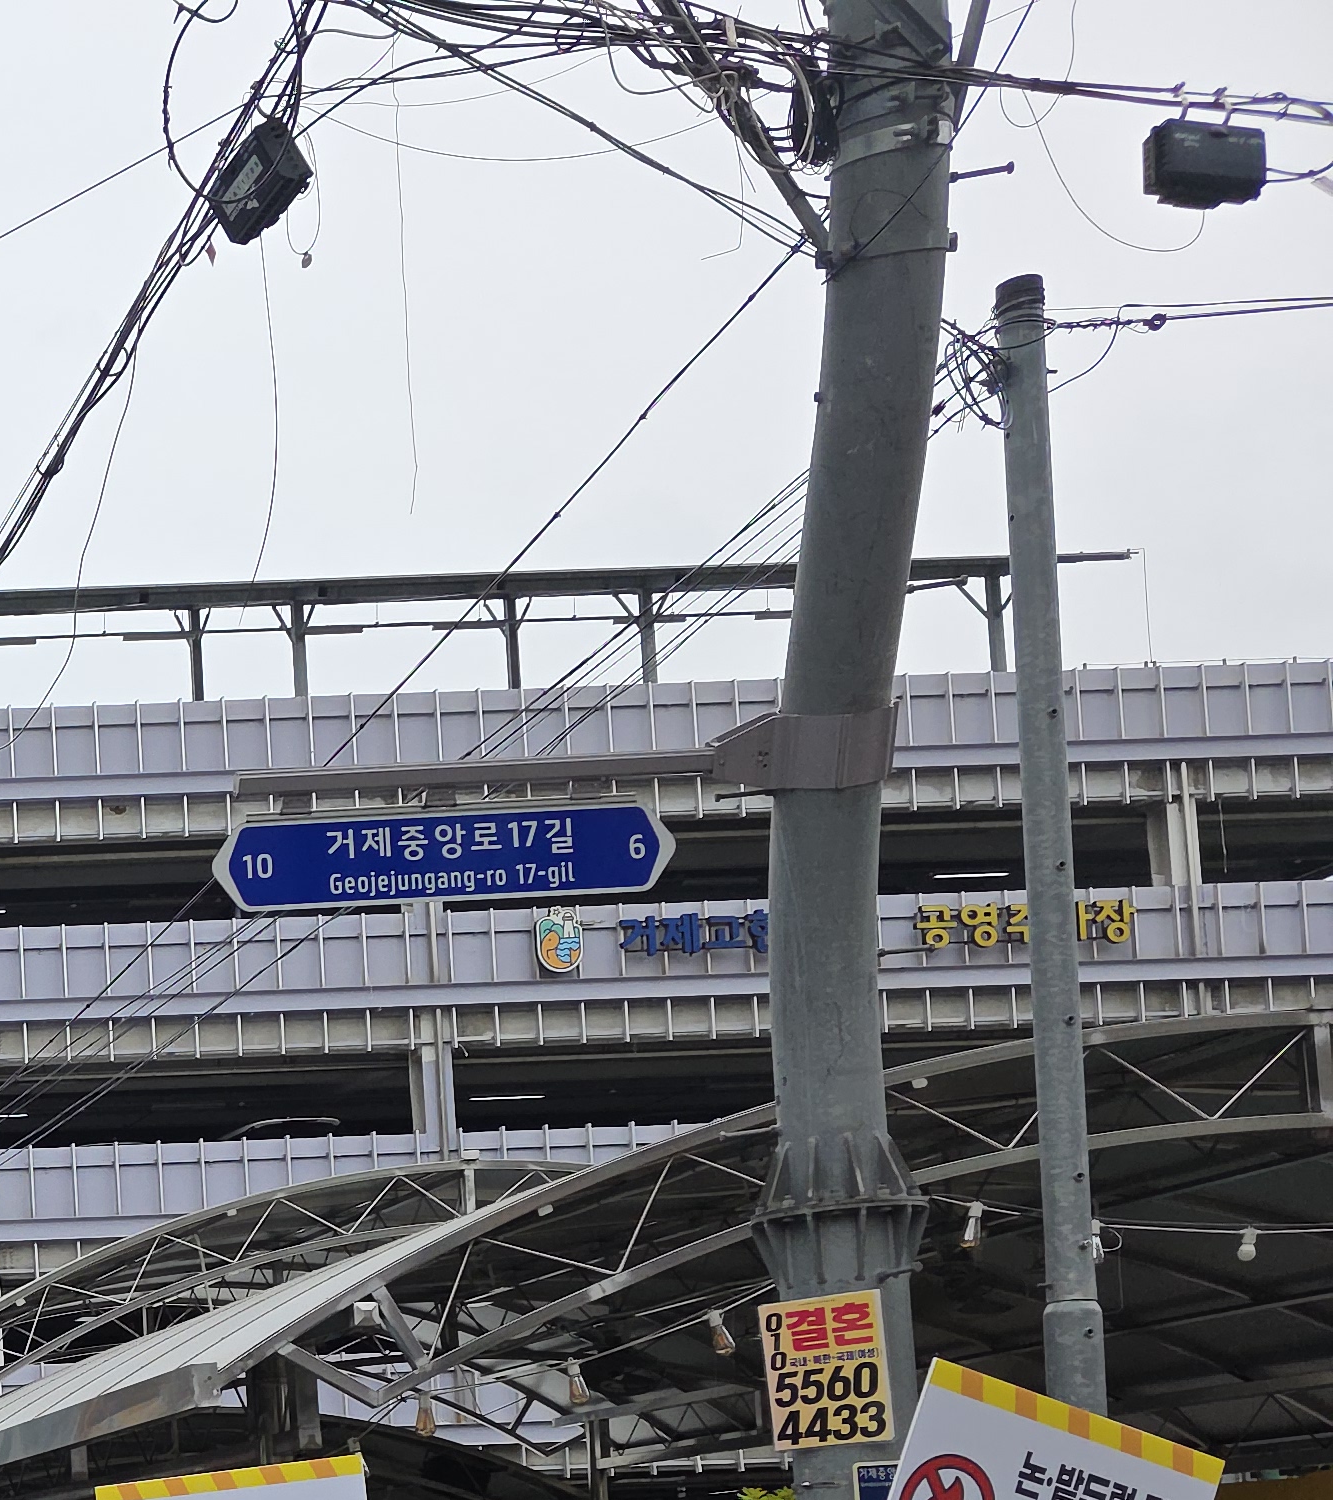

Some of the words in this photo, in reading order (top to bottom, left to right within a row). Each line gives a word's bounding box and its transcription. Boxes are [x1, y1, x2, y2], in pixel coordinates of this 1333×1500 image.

[242, 852, 274, 880] 10
[628, 833, 646, 861] 6
[329, 869, 508, 897] Geojejungang-ro
[516, 860, 576, 888] 17-gil
[914, 899, 1138, 948] 공영주장
[784, 1301, 875, 1353] 결혼
[774, 1361, 879, 1409] 5560
[776, 1400, 887, 1446] 4433
